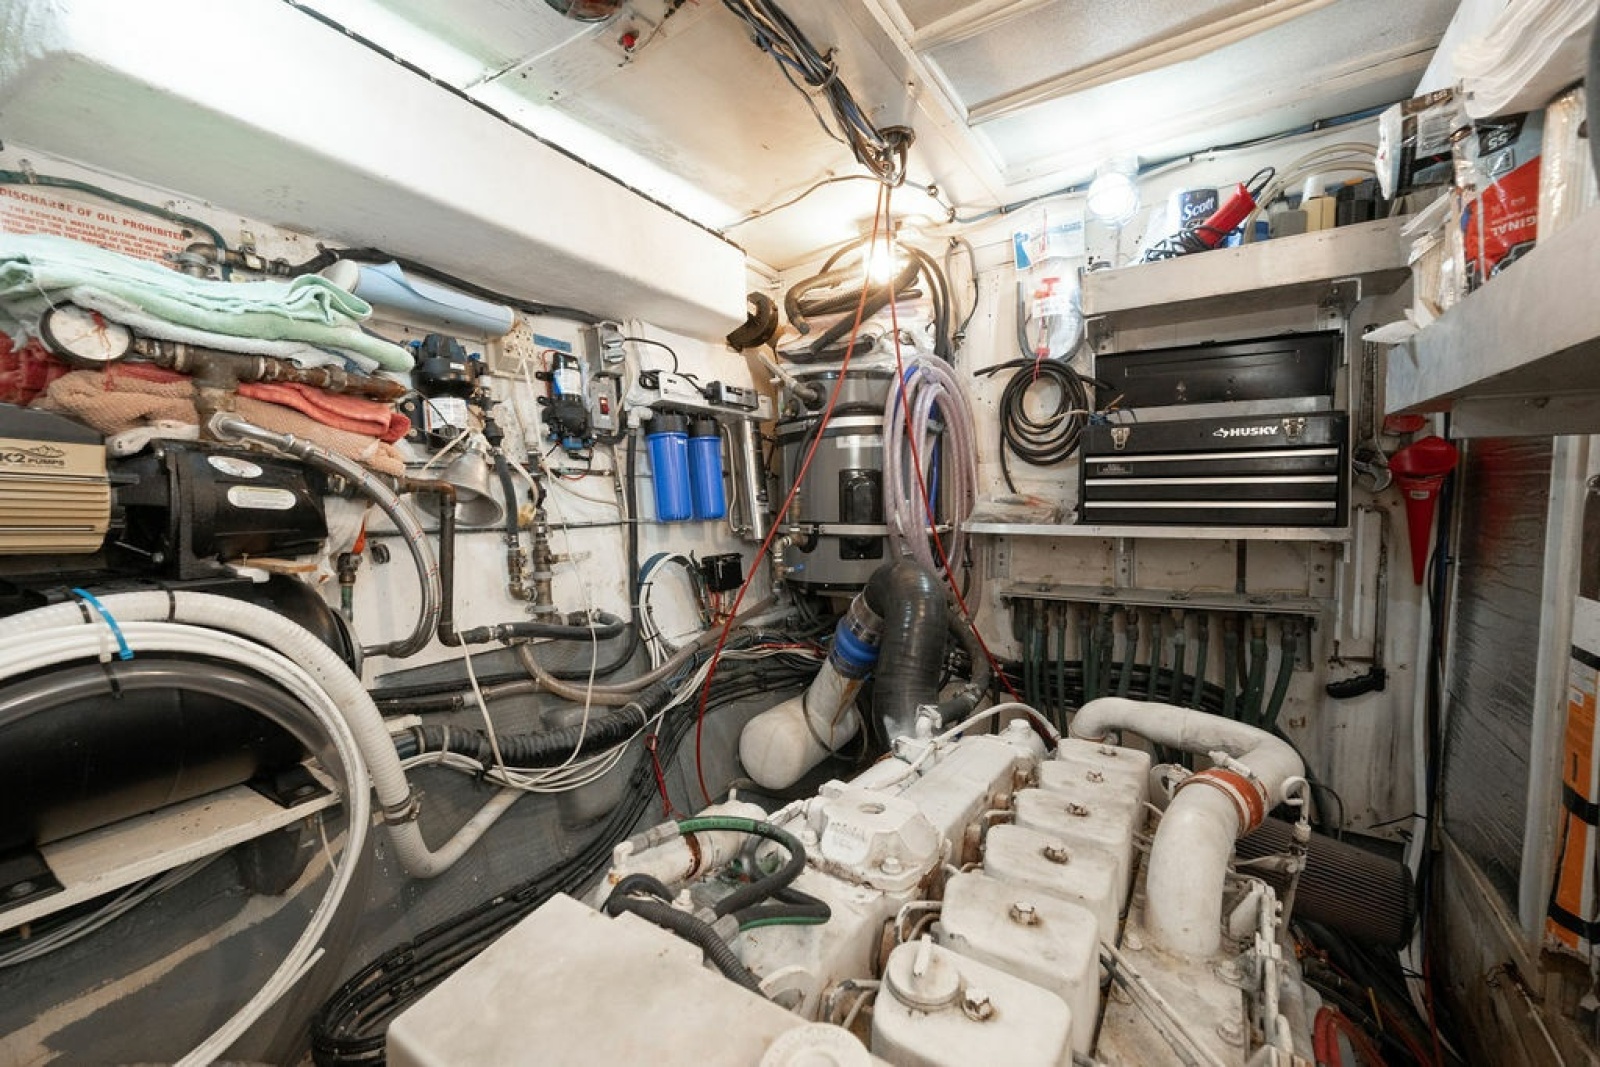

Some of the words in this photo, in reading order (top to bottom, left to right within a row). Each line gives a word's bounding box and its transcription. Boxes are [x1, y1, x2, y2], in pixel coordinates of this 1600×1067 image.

[0, 187, 73, 213] DISCHARGE
[77, 207, 92, 217] OF
[97, 212, 118, 224] OIL
[122, 218, 186, 241] PROHIBITED
[1182, 197, 1215, 221] Scott
[1229, 425, 1279, 437] HUSKY
[0, 452, 26, 463] K2
[28, 458, 65, 466] PUMPS
